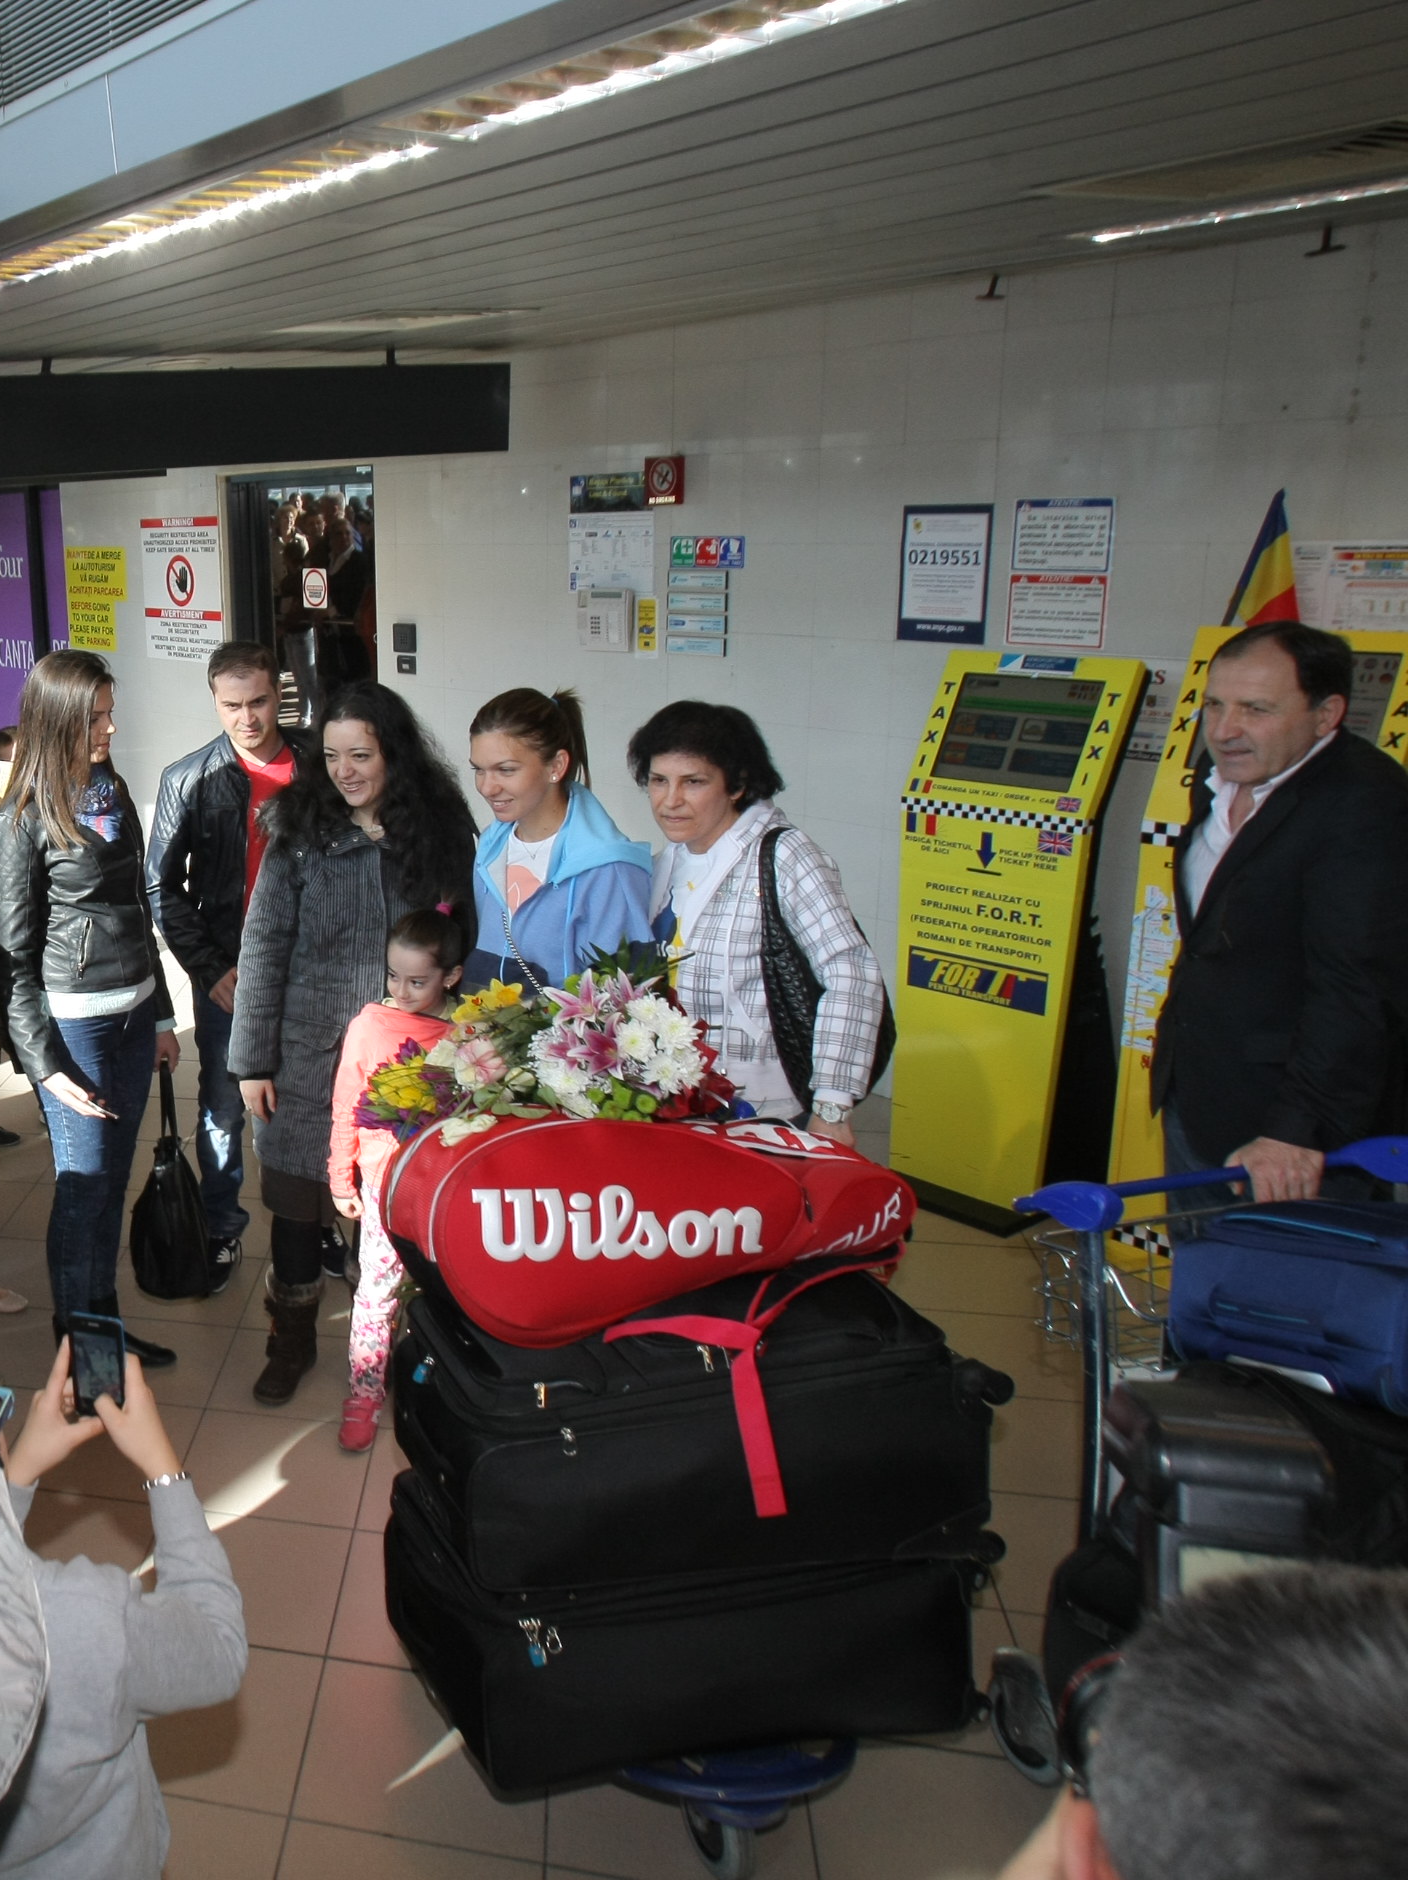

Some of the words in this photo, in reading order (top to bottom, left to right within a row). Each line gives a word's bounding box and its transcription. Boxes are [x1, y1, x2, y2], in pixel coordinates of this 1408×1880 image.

[908, 549, 981, 566] 0219551
[71, 601, 92, 611] BEFORE
[92, 602, 111, 612] GOING
[160, 609, 204, 620] AVERTISMENT
[72, 613, 81, 622] TO
[81, 613, 96, 623] YOUR
[96, 615, 109, 623] CAR
[69, 624, 90, 634] PLEASE
[90, 626, 101, 635] PAY
[101, 627, 114, 636] FOR
[74, 636, 85, 645] THE
[86, 637, 111, 647] PARKING
[1166, 660, 1207, 760] TAXI
[918, 681, 956, 767] TAXI
[1081, 693, 1121, 786] TAXI
[904, 834, 931, 845] RIDICA
[933, 838, 974, 851] TICHETUL
[920, 844, 931, 852] DE
[933, 846, 950, 855] AICI
[998, 856, 1029, 867] TICKET
[1033, 862, 1058, 872] HERE
[999, 848, 1019, 858] PICK
[1020, 851, 1033, 860] UP
[1034, 854, 1058, 864] YOUR
[925, 881, 970, 896] PROIECT
[971, 889, 1023, 905] REALIZAT
[1025, 898, 1041, 908] CU
[920, 898, 973, 916] SPRIJINUL
[976, 903, 1043, 929] F.O.R.T.
[910, 913, 969, 932] (FEDERATIA
[970, 925, 1052, 948] OPERATORILOR
[917, 930, 956, 944] ROMANI
[958, 938, 972, 948] DE
[975, 941, 1042, 964] TRANSPORT)
[928, 981, 960, 995] PENTRU
[961, 988, 1011, 1006] TRANSPORT
[471, 1185, 763, 1263] Wilson
